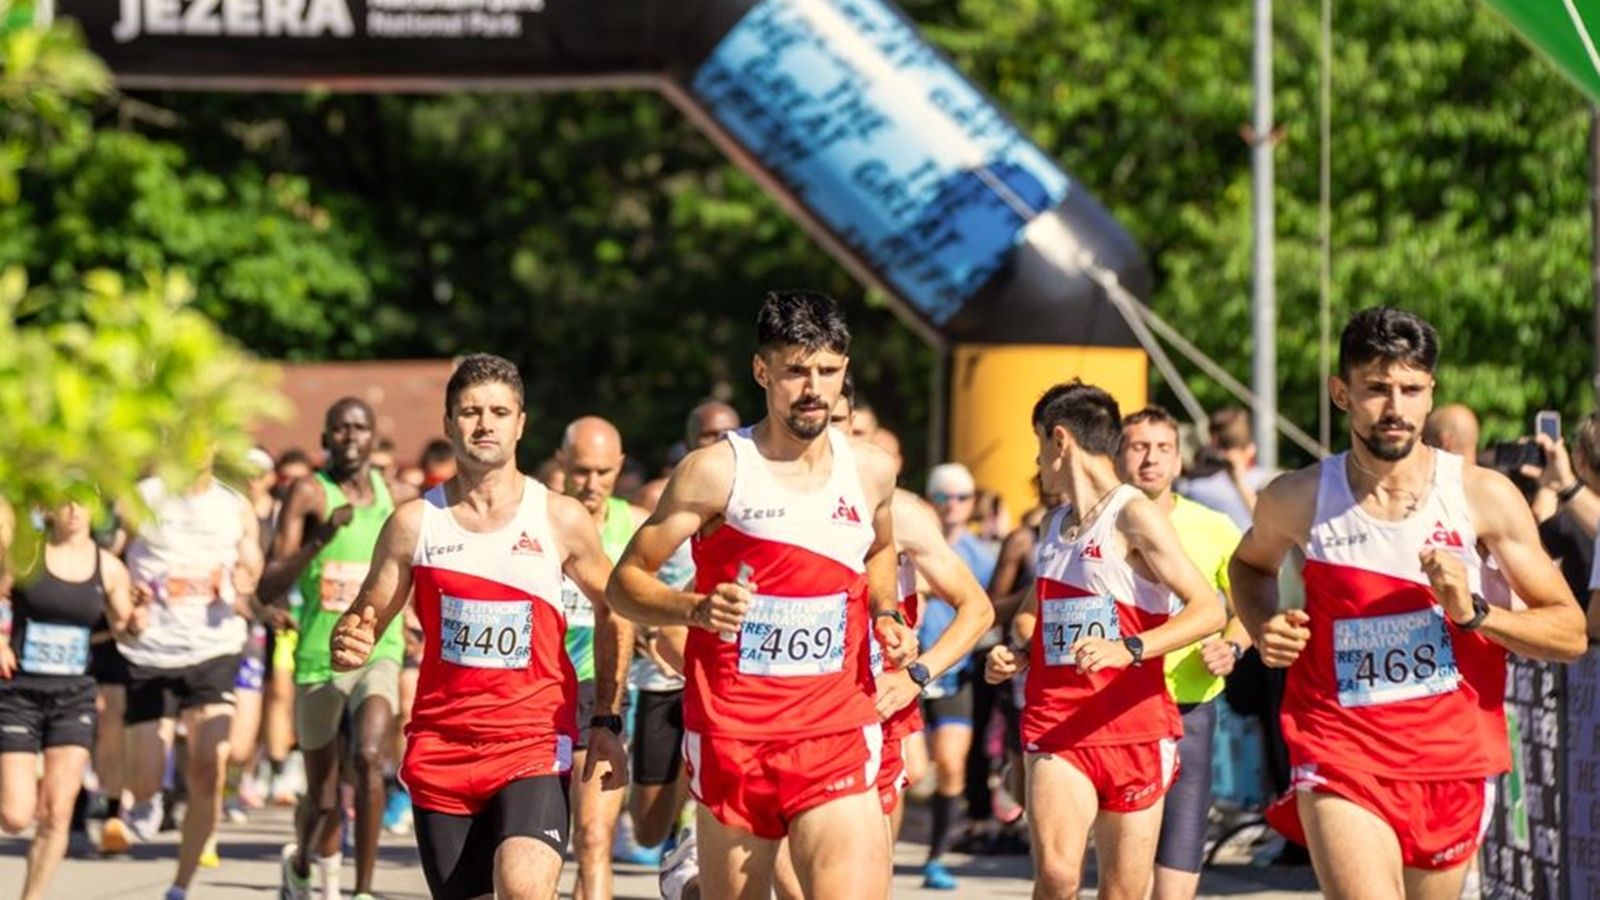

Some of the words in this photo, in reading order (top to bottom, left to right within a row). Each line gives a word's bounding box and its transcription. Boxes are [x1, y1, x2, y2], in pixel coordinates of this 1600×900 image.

[112, 0, 355, 43] JEZERA
[454, 625, 517, 656] 440
[759, 626, 832, 661] 469
[1052, 621, 1105, 652] 470
[1335, 631, 1409, 650] MARATON
[1356, 643, 1437, 688] 468
